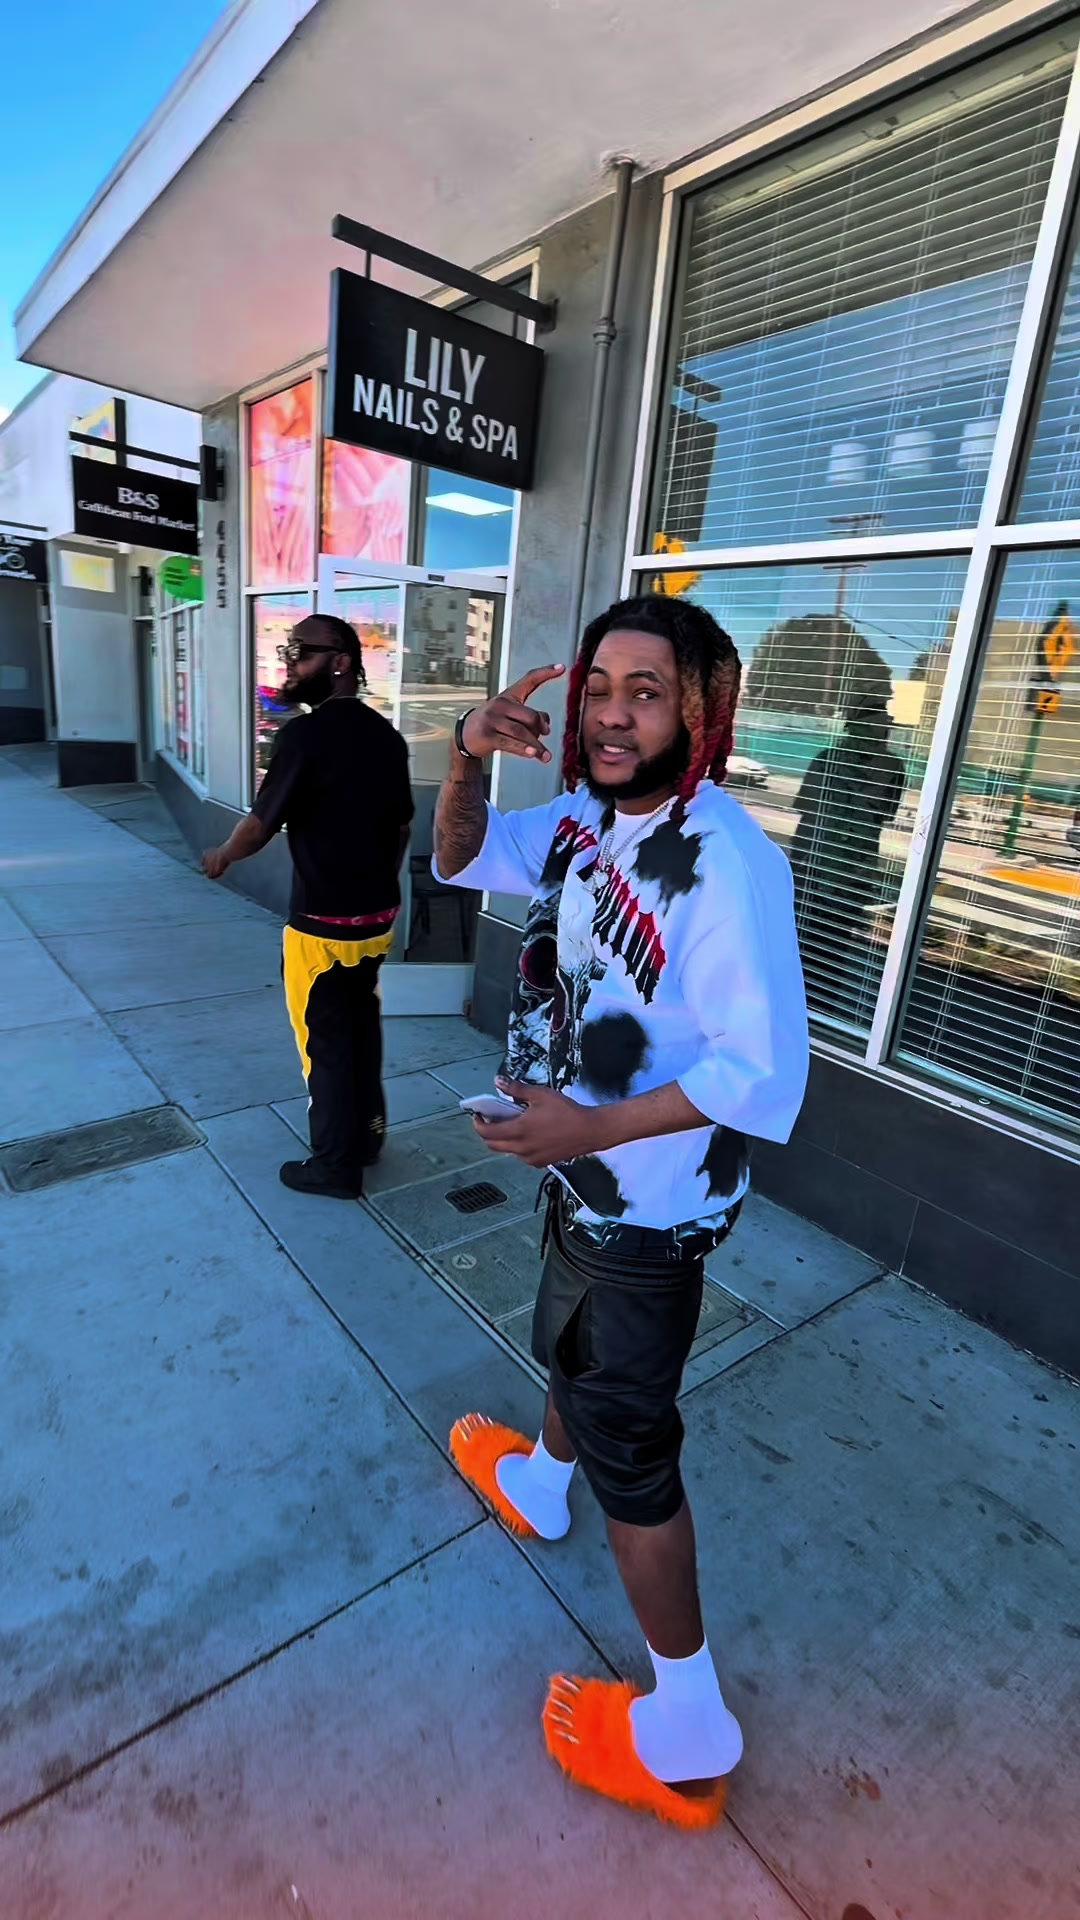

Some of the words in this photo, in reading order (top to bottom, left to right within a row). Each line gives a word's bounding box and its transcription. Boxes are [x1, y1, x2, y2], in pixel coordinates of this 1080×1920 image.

[404, 328, 486, 404] LILY
[353, 373, 440, 435] NAILS
[445, 406, 464, 443] &
[469, 414, 518, 461] SPA
[117, 487, 160, 510] B&S
